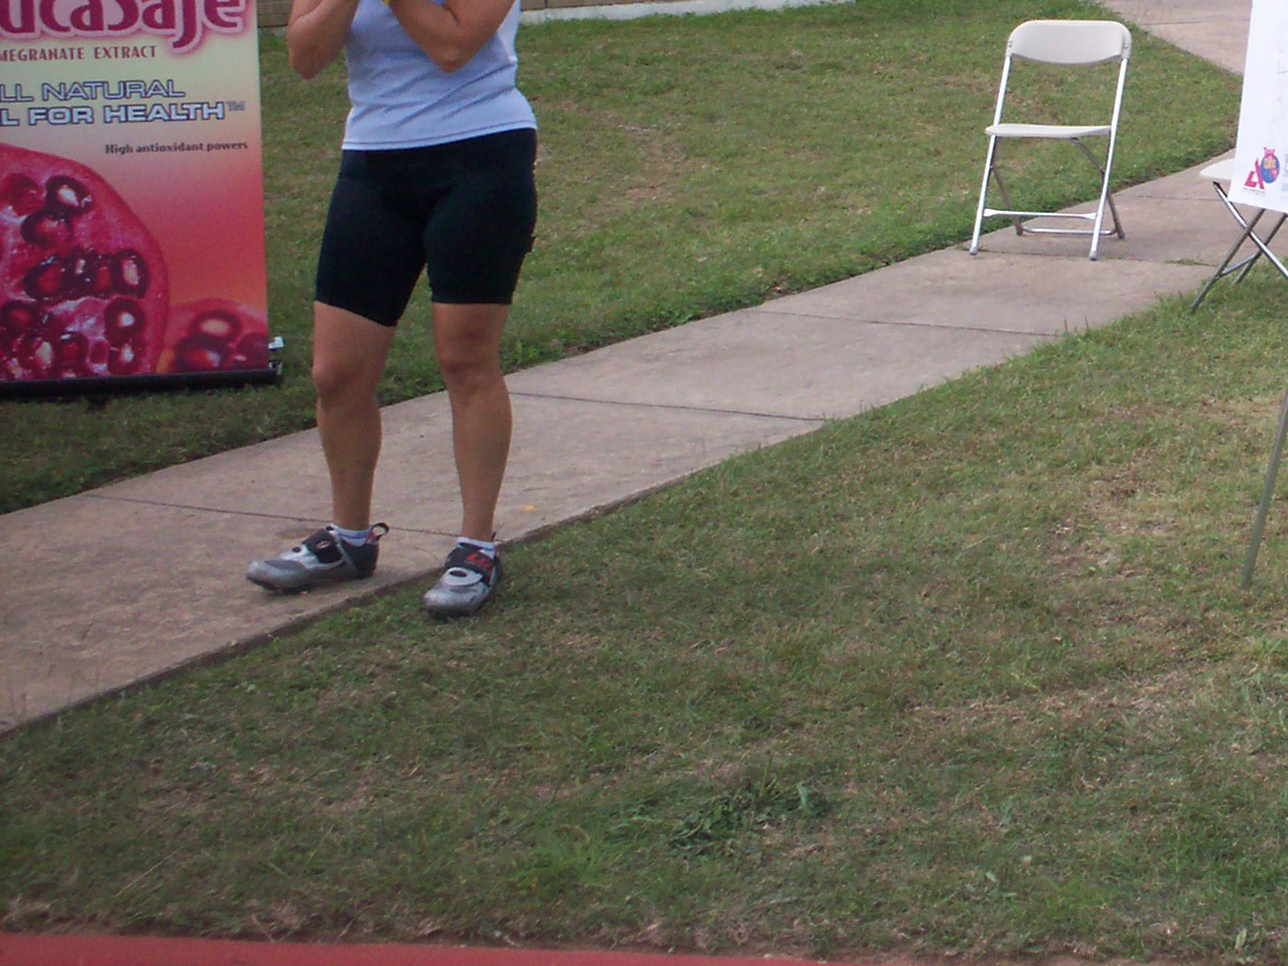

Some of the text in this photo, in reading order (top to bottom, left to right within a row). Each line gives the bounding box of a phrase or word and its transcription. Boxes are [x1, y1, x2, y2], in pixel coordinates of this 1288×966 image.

[94, 45, 156, 59] EXTRACT
[42, 80, 185, 101] NATURAL
[28, 106, 94, 125] FOR
[103, 102, 225, 123] HEALTH
[105, 141, 248, 154] High antioxidant powers
